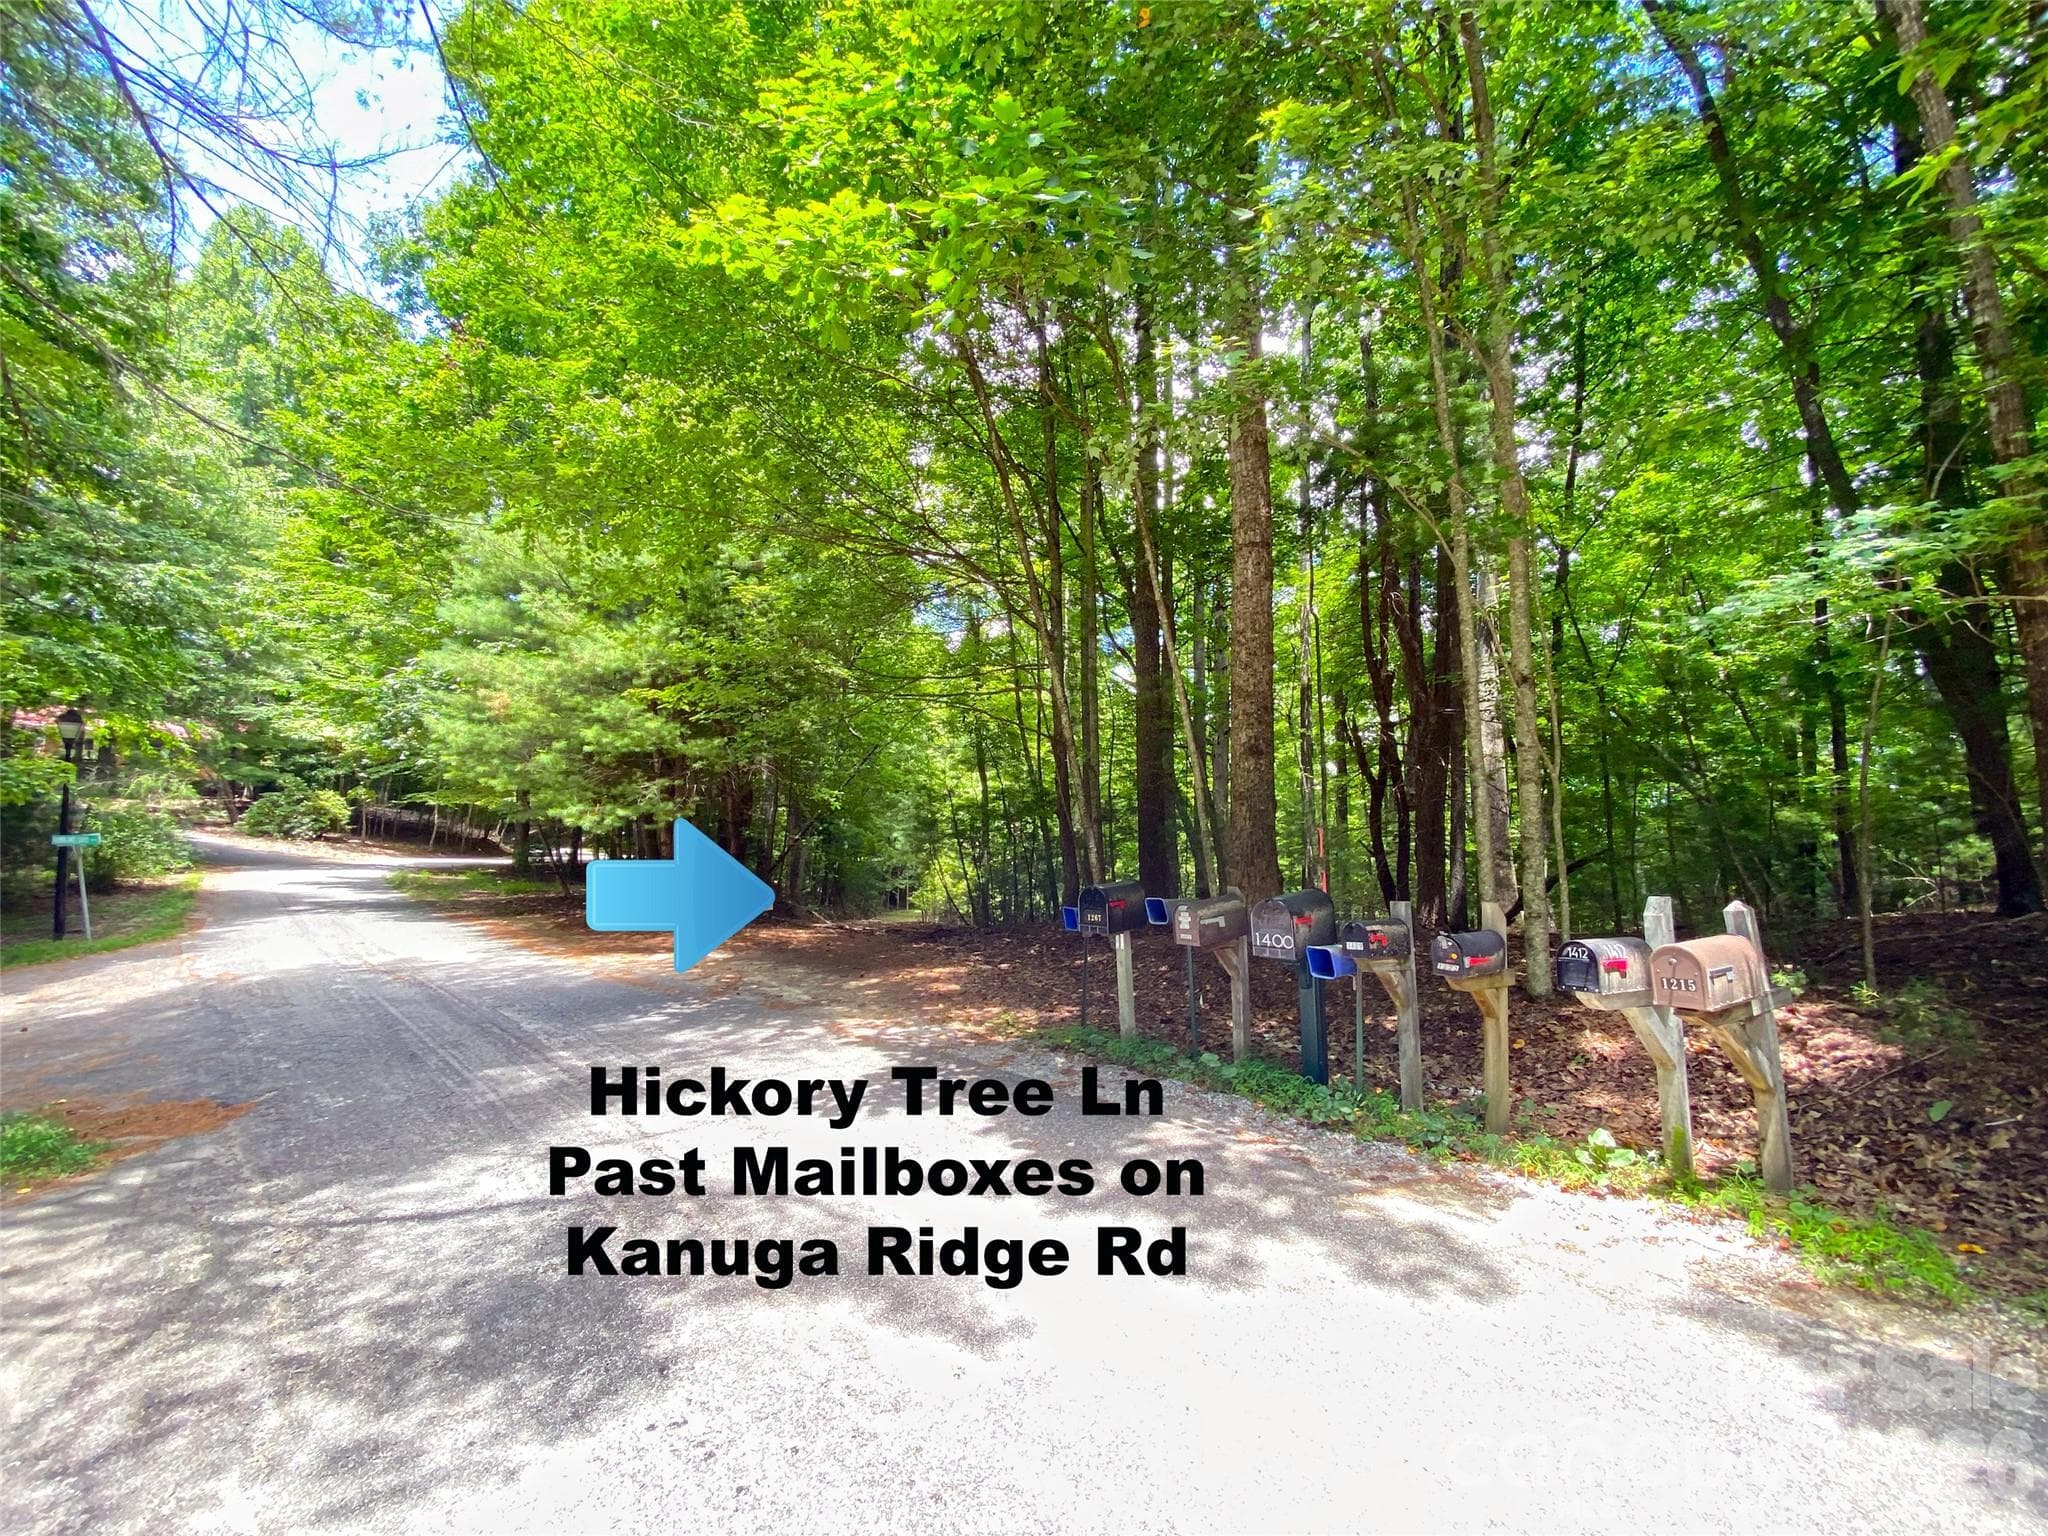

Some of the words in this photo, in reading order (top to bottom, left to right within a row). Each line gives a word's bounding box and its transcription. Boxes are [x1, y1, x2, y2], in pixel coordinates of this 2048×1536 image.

[1255, 932, 1295, 950] 1400
[1567, 946, 1589, 959] 1412
[1661, 977, 1697, 992] 1215
